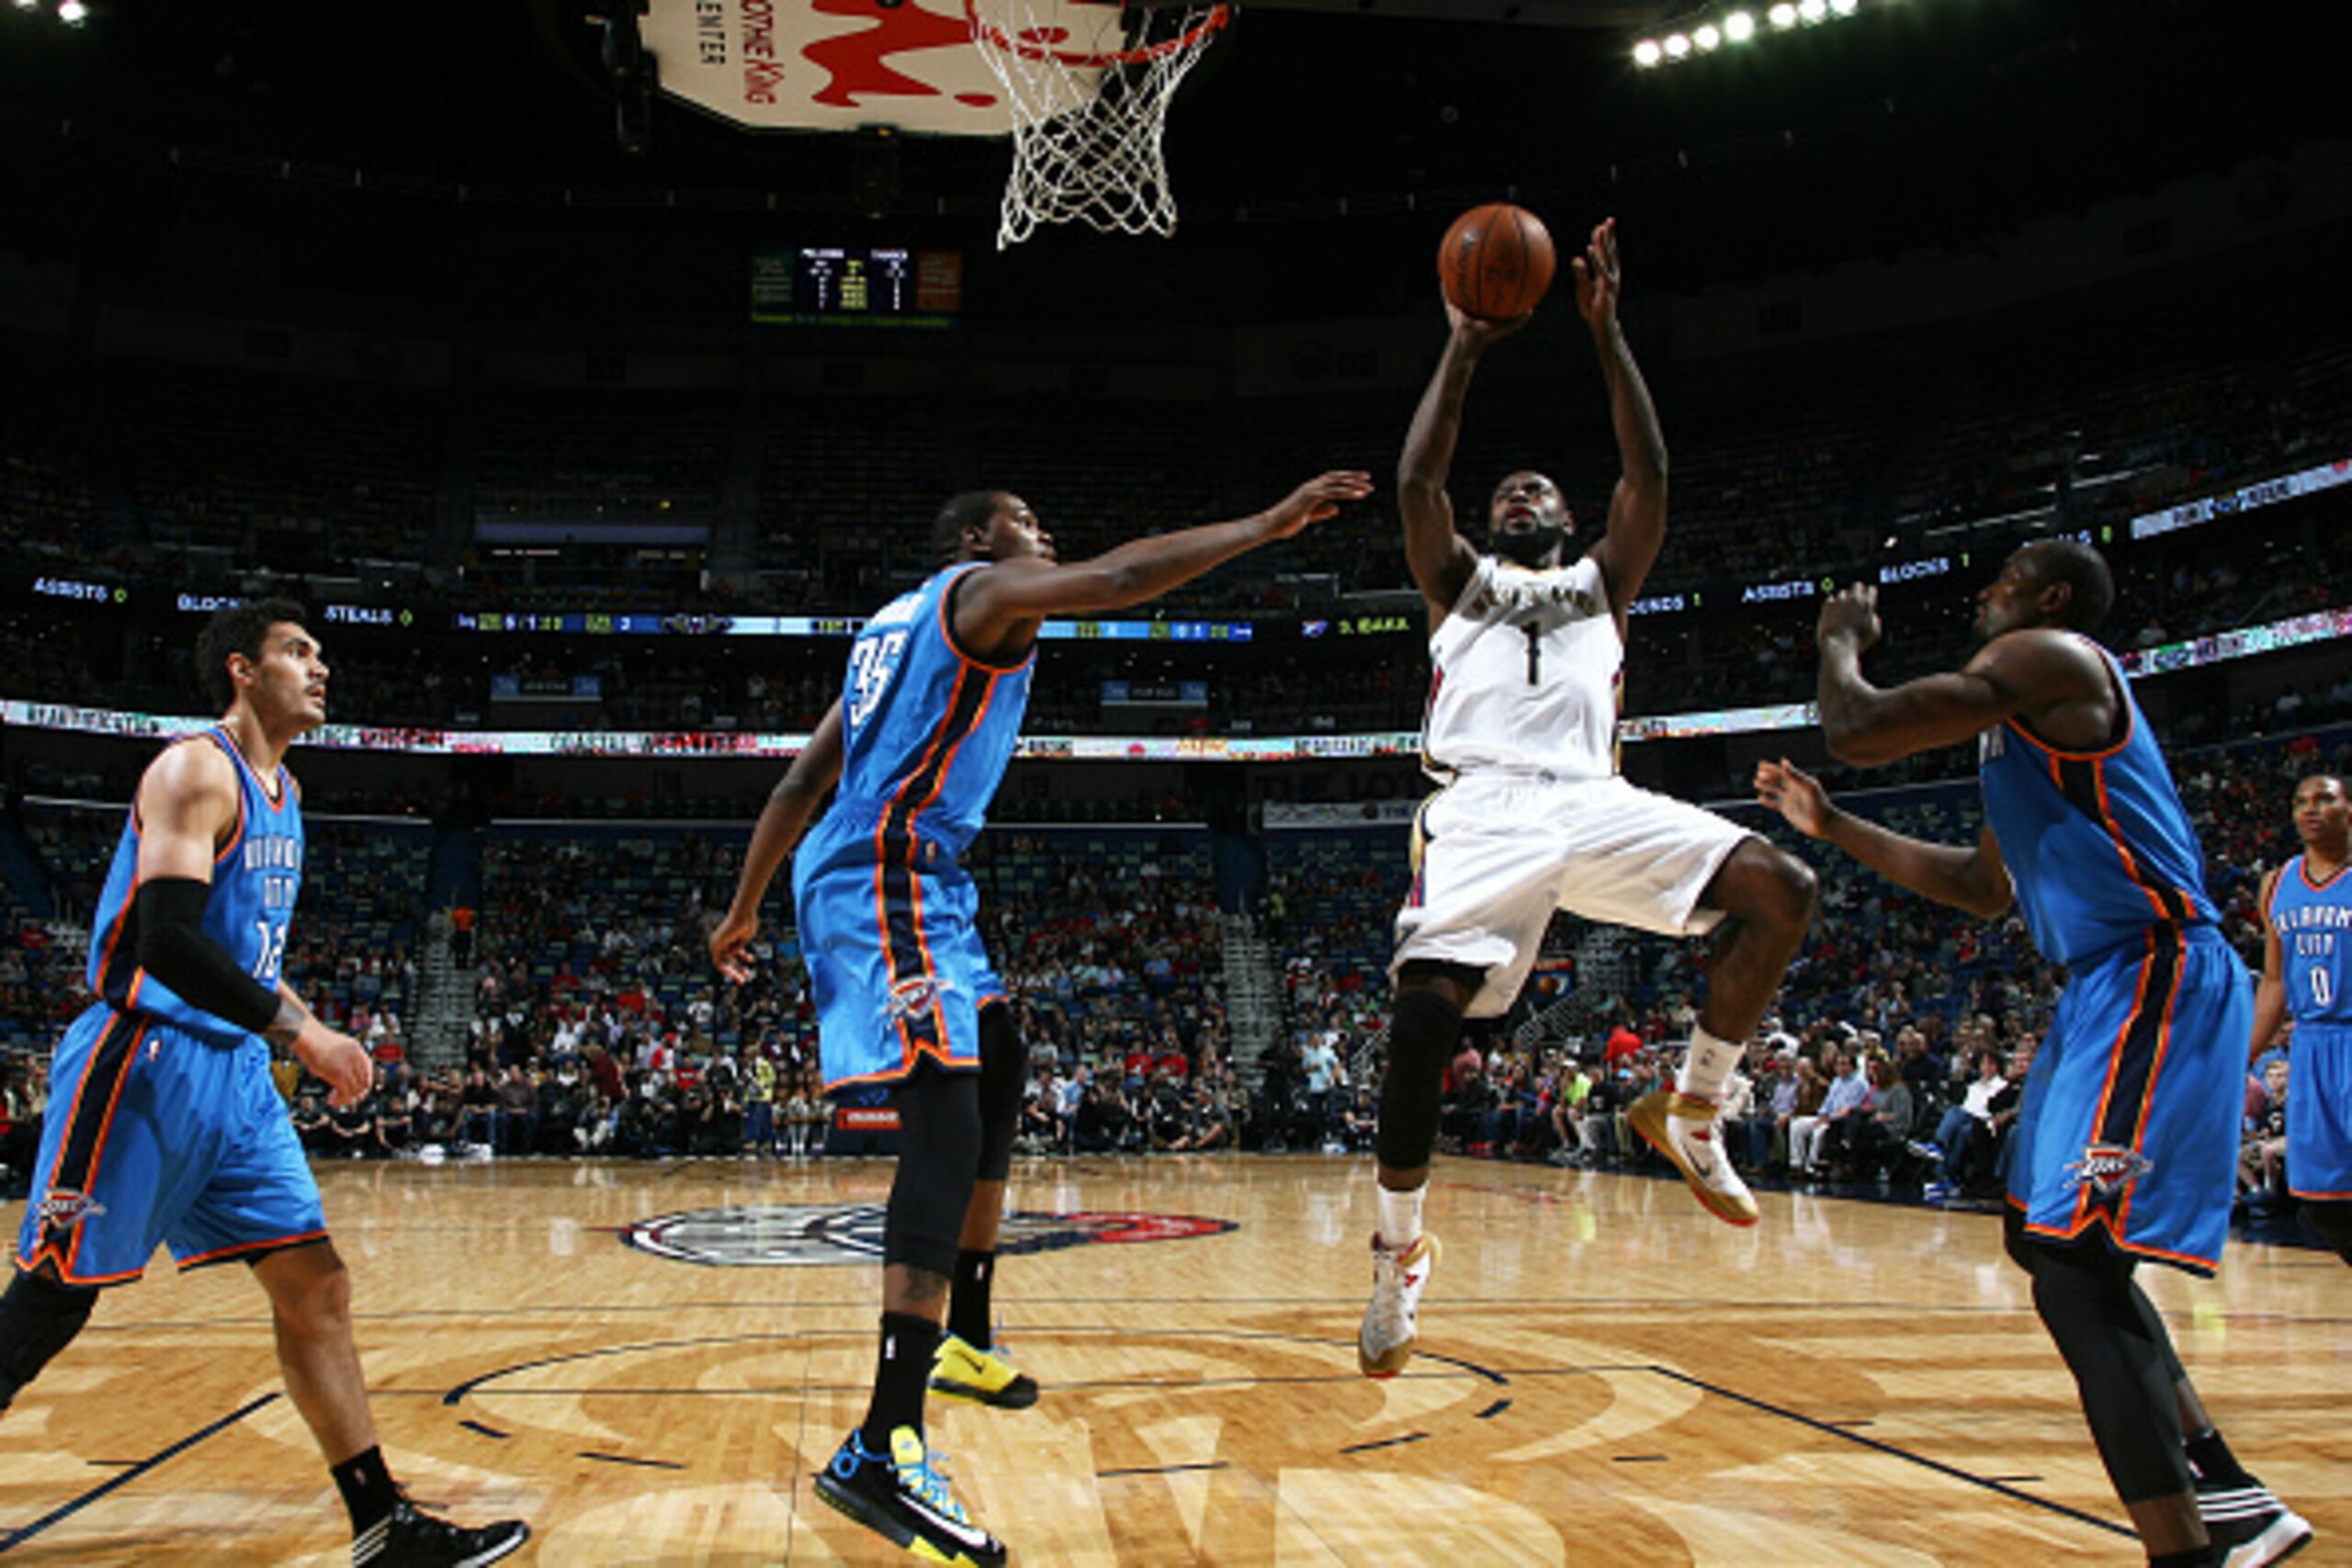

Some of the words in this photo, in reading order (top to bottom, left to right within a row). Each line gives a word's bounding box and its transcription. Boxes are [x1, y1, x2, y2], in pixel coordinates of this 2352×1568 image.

[1880, 557, 1950, 583] BLOCKS
[1961, 553, 1970, 568] 1
[33, 577, 107, 603] ASSISTS
[114, 589, 128, 603] 0
[1741, 581, 1815, 603] ASSISTS
[1821, 577, 1834, 593] 0
[323, 605, 393, 626] STEALS
[399, 609, 413, 626] 0
[1520, 620, 1541, 686] 1
[850, 628, 908, 728] 35
[2311, 966, 2332, 1006] 0
